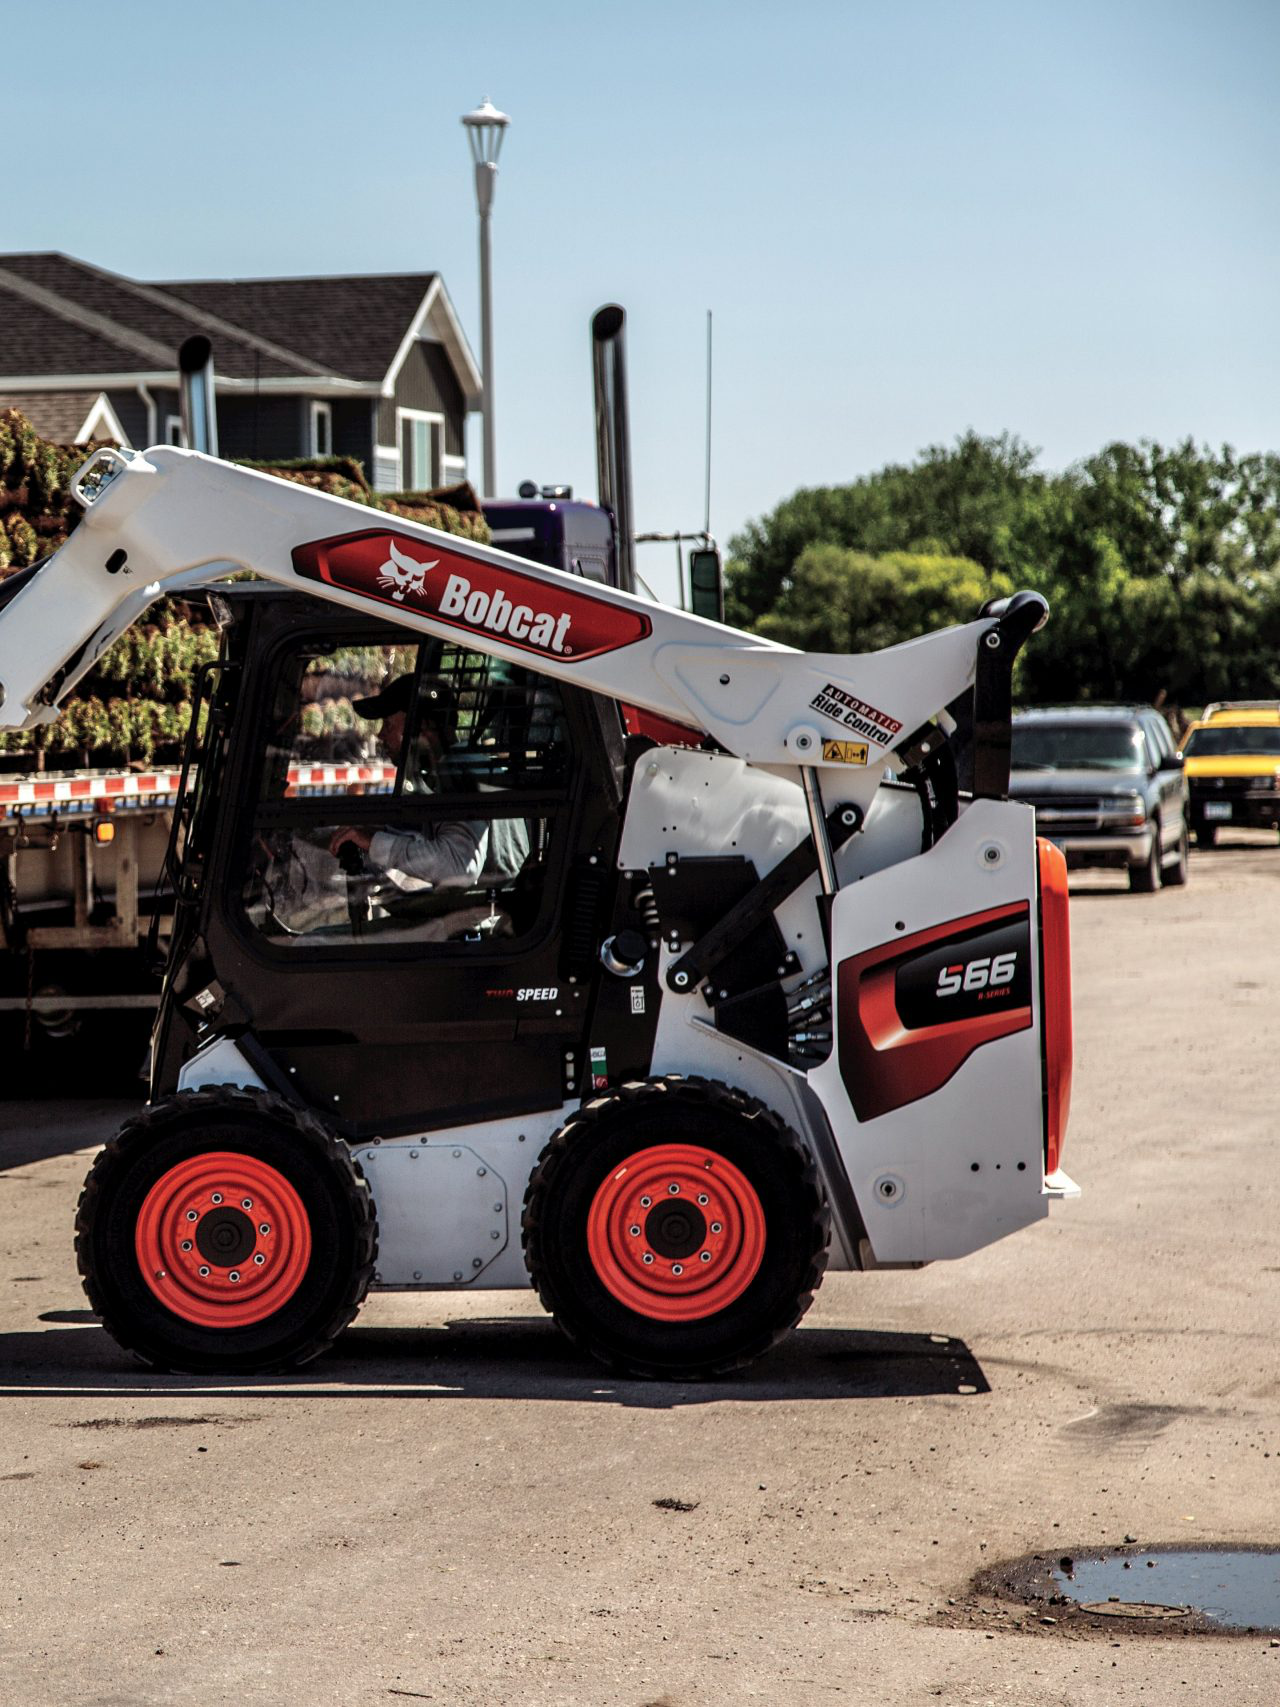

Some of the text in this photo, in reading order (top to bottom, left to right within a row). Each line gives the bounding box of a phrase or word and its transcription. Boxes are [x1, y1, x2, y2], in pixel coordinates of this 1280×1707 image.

[438, 573, 572, 653] Bobcat
[811, 693, 895, 746] Ride Control
[825, 686, 900, 733] AUTOMATIC
[516, 987, 559, 1001] SPEED
[936, 952, 1017, 997] S66
